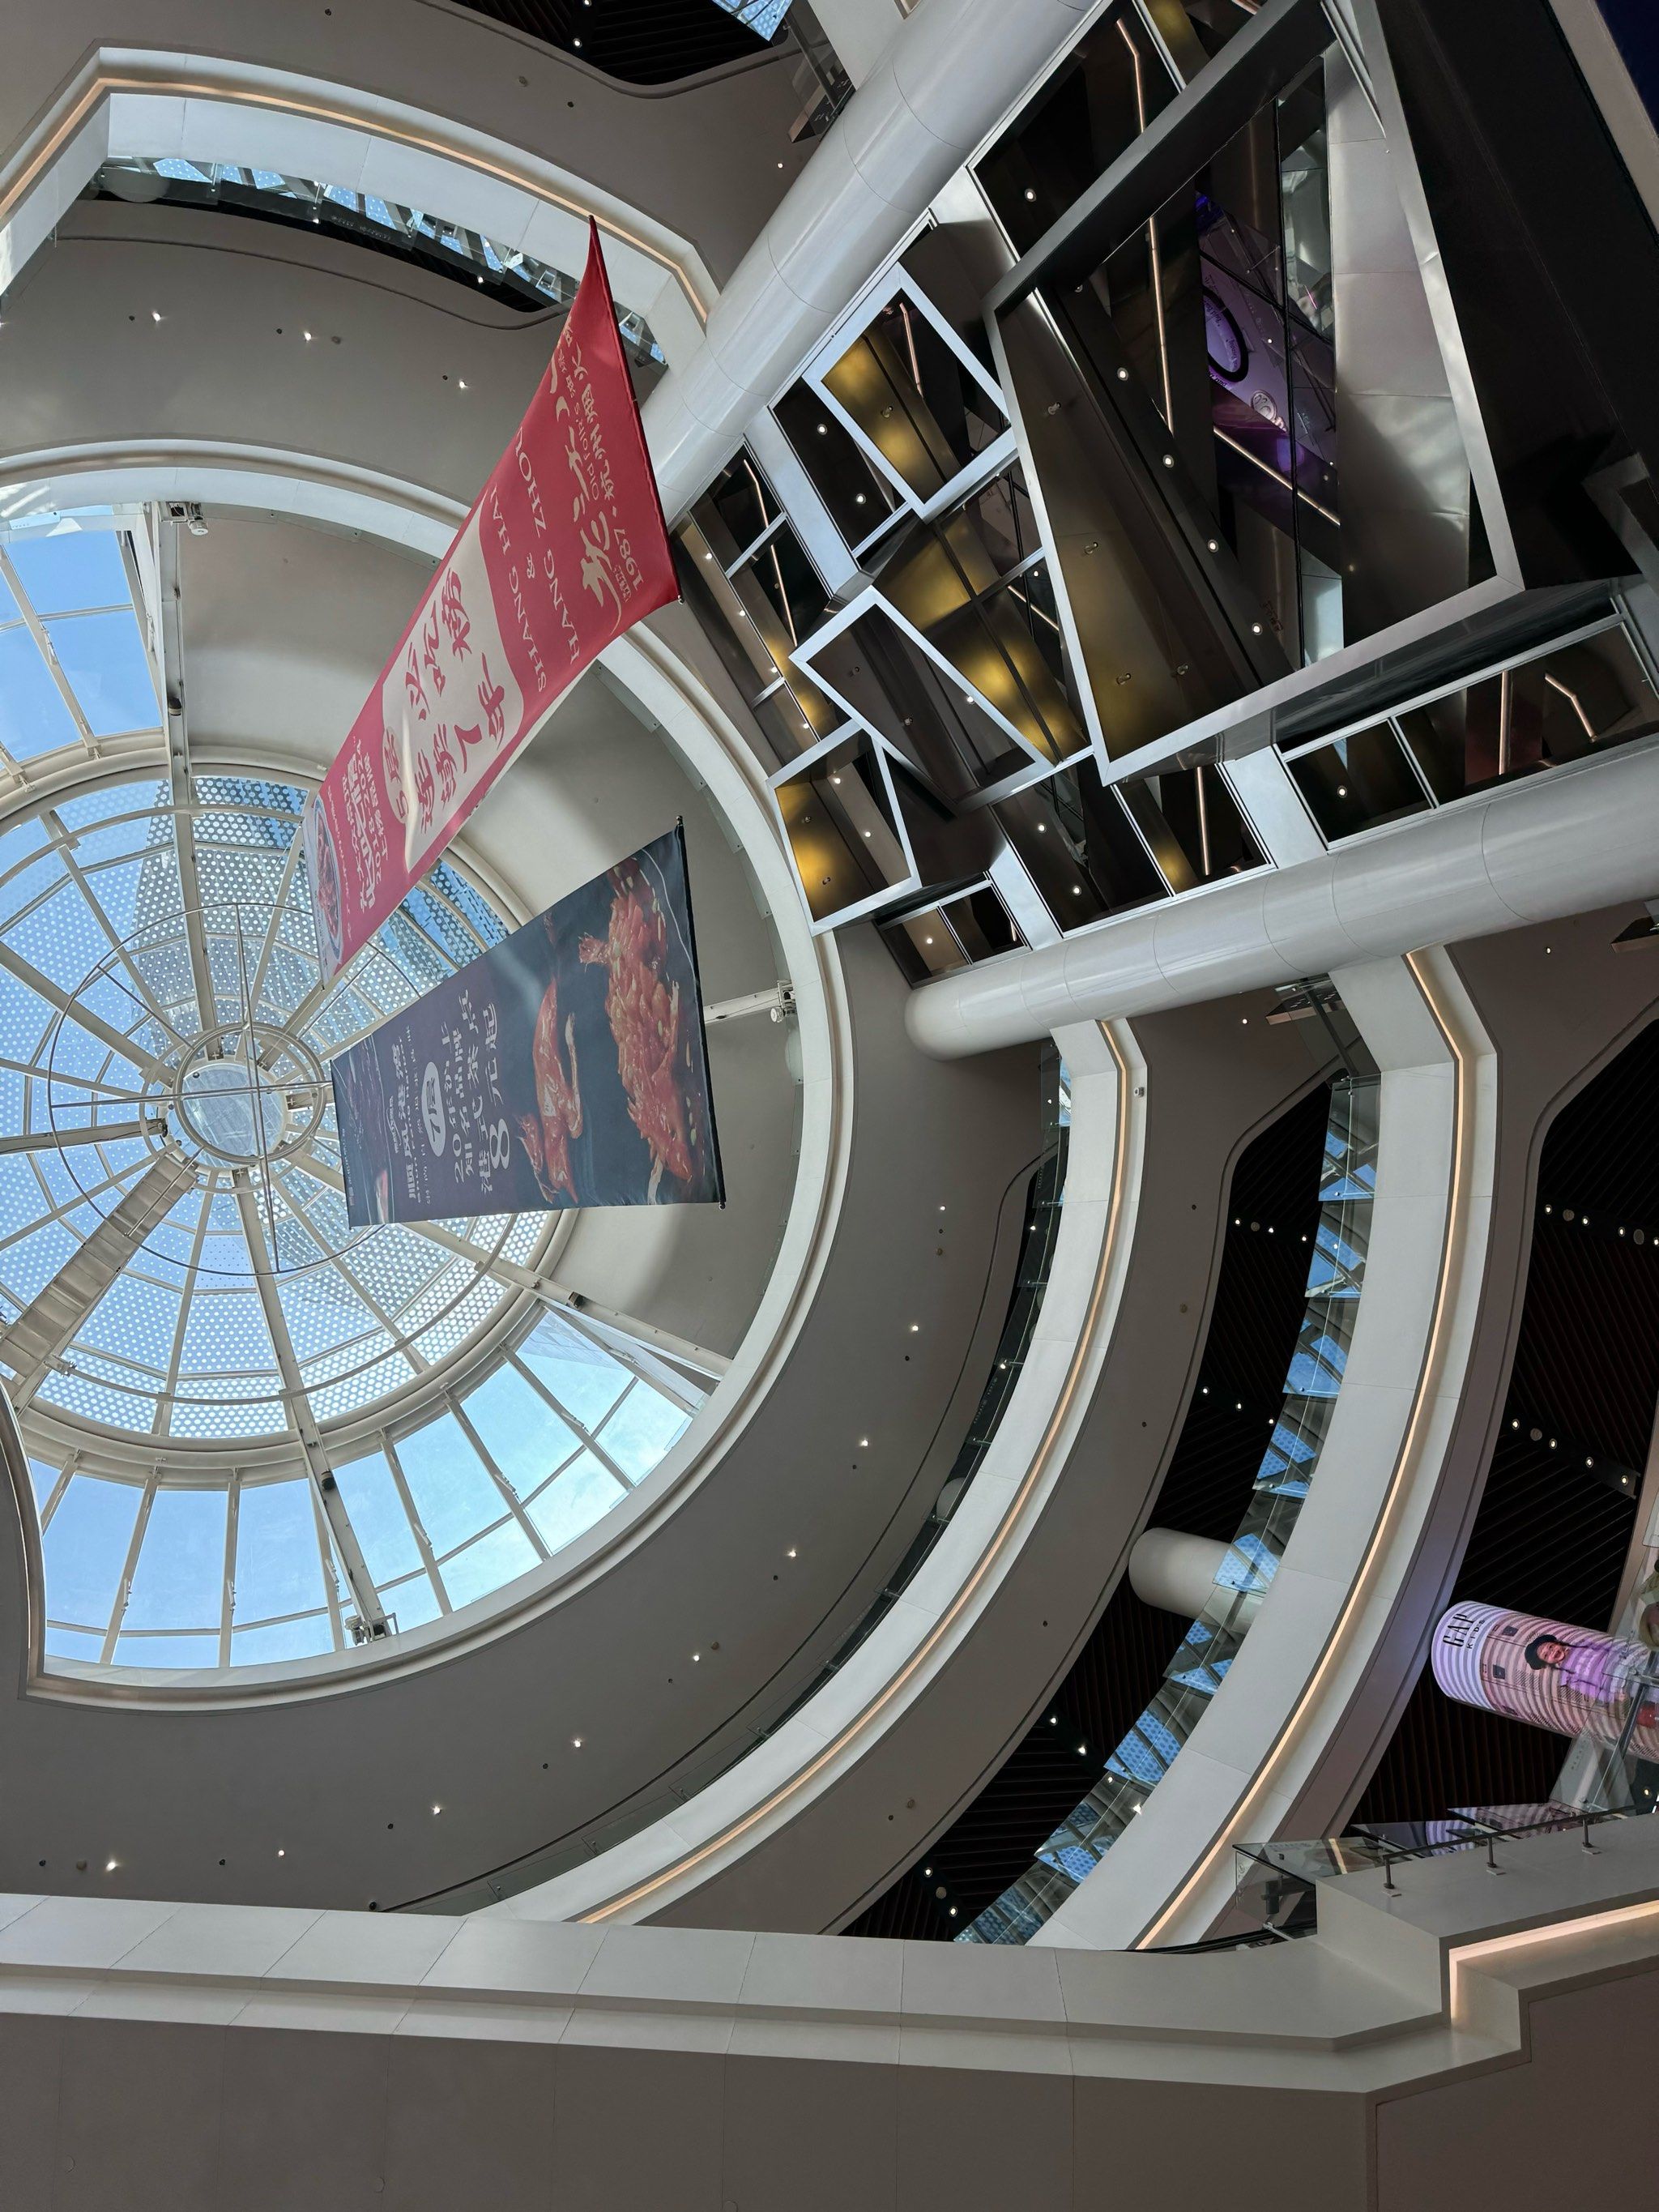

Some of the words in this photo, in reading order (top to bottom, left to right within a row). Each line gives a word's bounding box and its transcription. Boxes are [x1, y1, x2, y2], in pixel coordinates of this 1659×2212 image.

[489, 485, 510, 555] HAI
[515, 425, 546, 538] ZHOU
[586, 461, 599, 503] Old
[527, 551, 535, 577] &
[543, 547, 580, 664] HANG
[405, 566, 471, 719] 必吃榜
[508, 564, 547, 692] SHANG
[382, 728, 409, 823] 5层
[413, 650, 505, 833] 连续7年
[364, 751, 387, 860] 上榜品牌
[390, 1043, 416, 1198] 顺风港湾
[424, 1077, 440, 1142] 7层
[441, 1021, 464, 1183] 20年沪上
[451, 1027, 474, 1174] 知名品牌
[458, 988, 492, 1193] 港式茶点
[481, 1001, 510, 1170] 8元起
[1443, 1613, 1475, 1647] GAP
